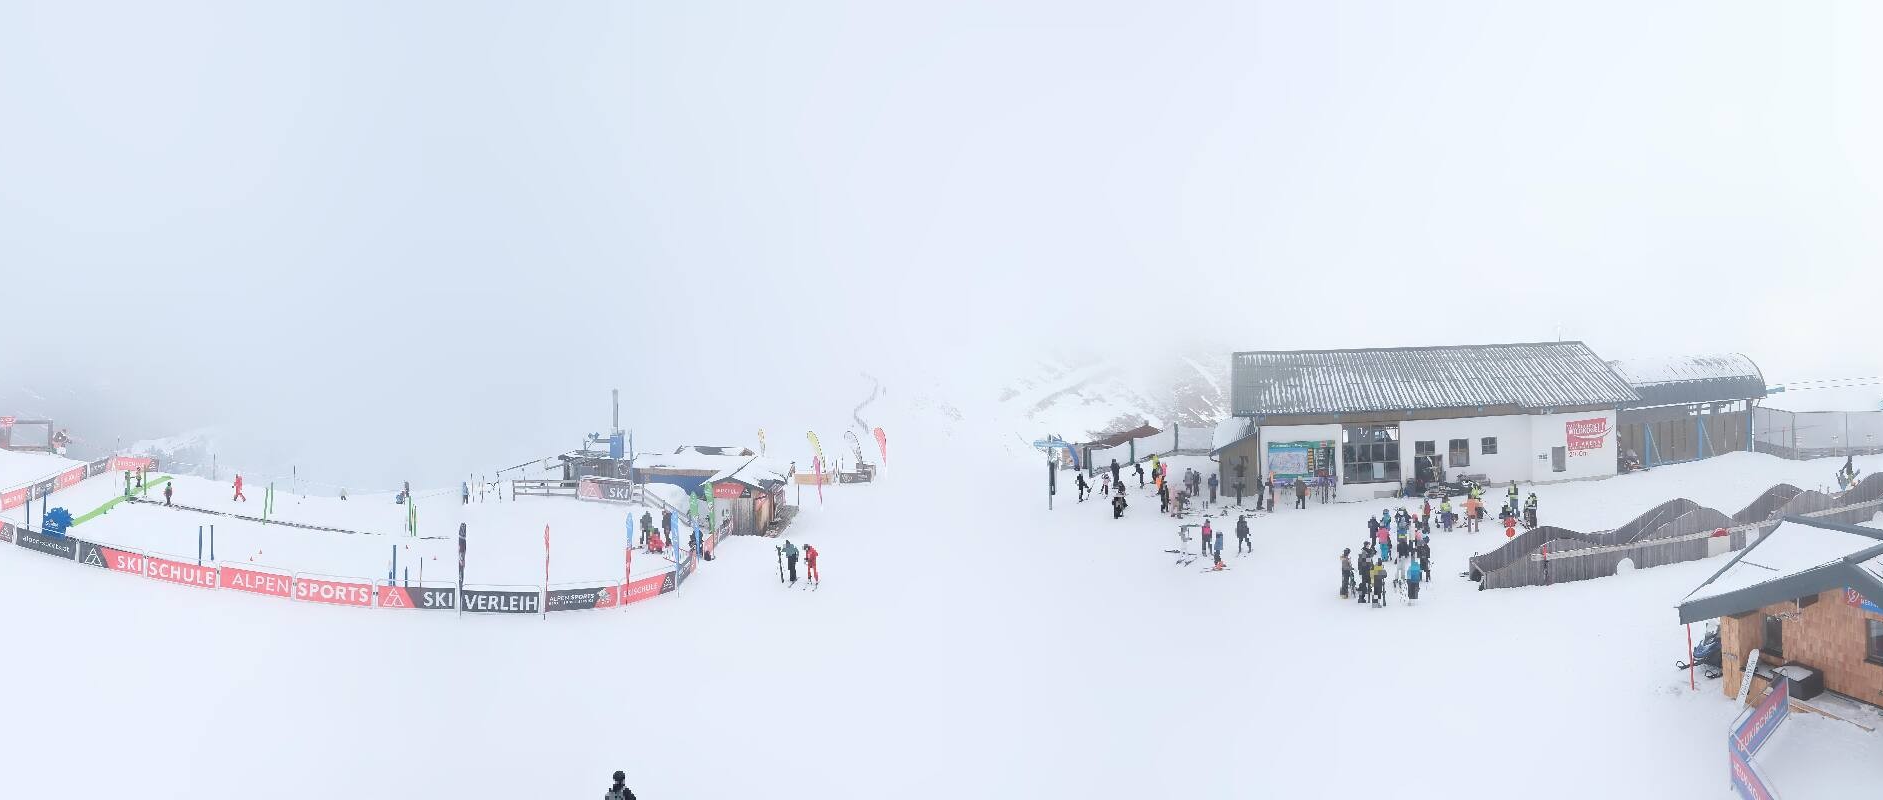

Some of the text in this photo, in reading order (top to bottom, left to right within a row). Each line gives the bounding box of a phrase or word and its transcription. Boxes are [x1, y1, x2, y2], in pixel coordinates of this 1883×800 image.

[609, 487, 629, 499] SKI
[117, 555, 369, 602] SKI SCHULE ALPEN SPORTS
[549, 593, 595, 602] ALPEN SPORTS
[623, 583, 658, 599] SKISCHULE
[423, 591, 453, 607] SKI
[464, 595, 538, 611] VERLEIH
